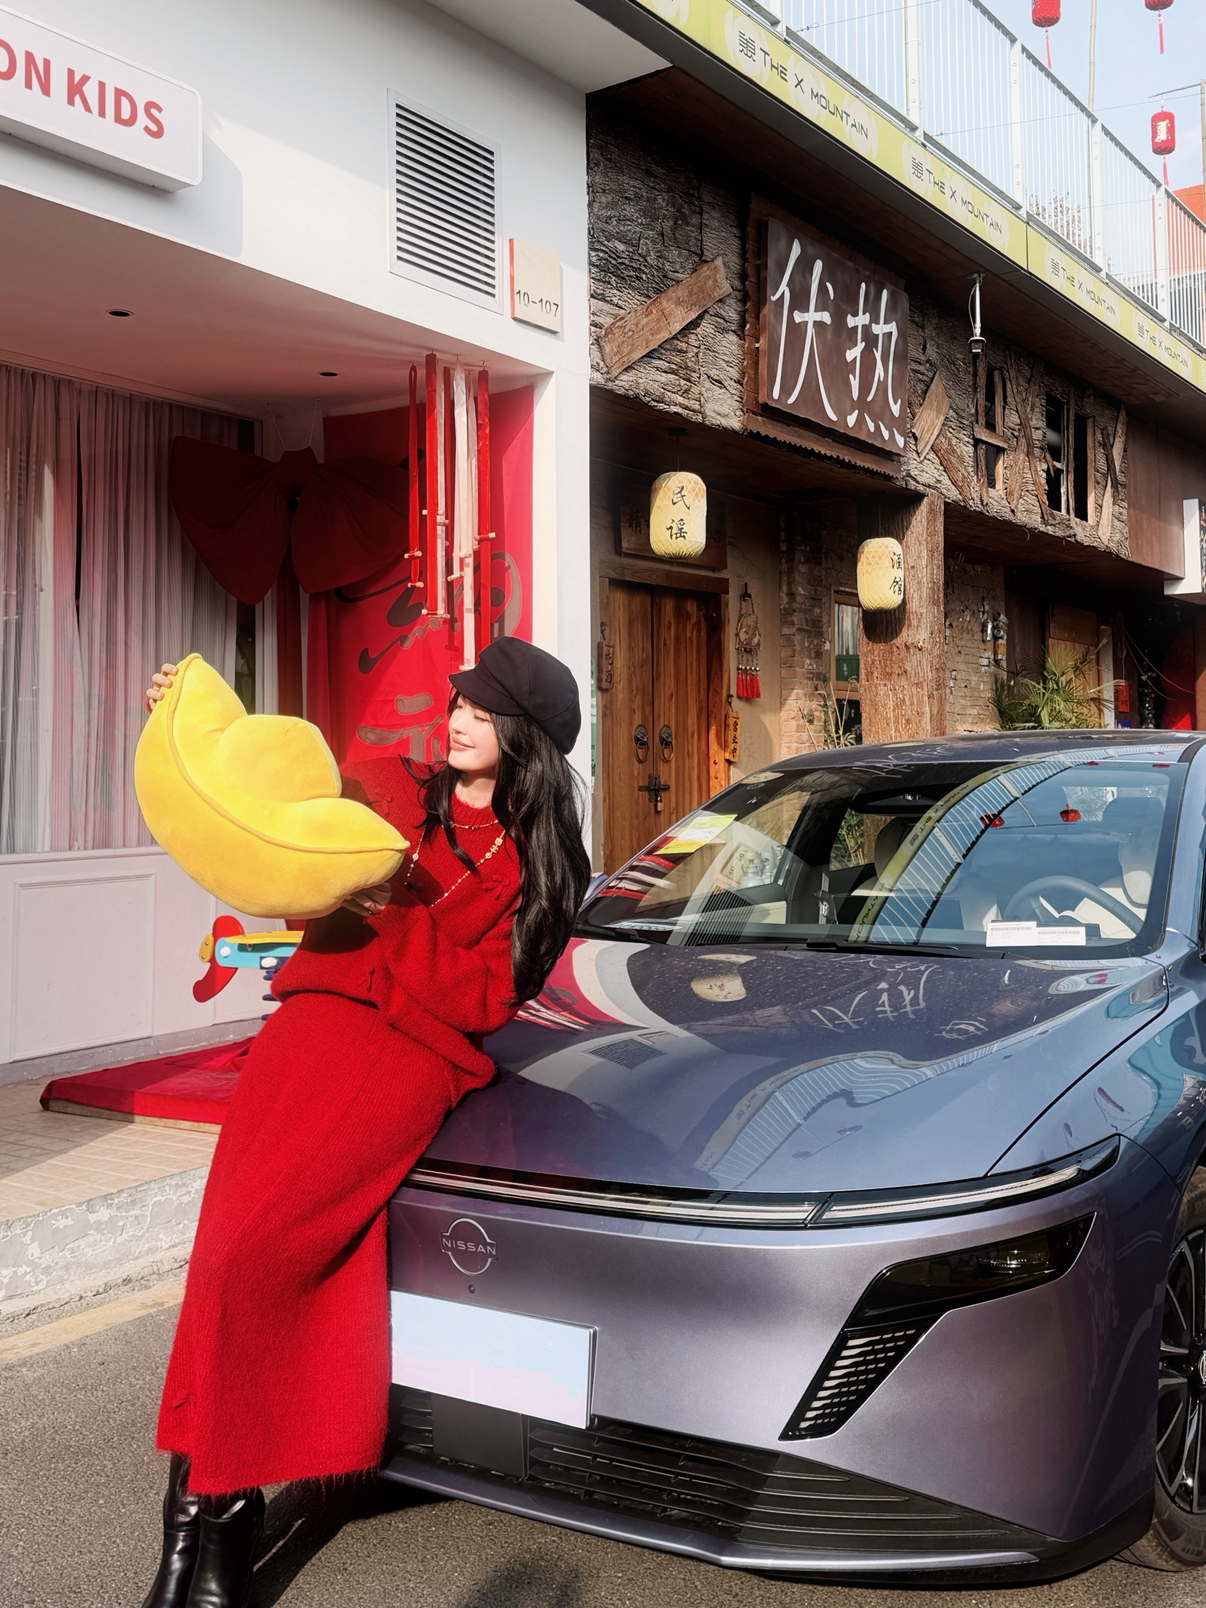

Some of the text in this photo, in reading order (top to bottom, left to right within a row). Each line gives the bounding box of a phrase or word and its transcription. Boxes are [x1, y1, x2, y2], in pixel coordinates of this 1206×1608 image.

[66, 67, 165, 140] KIDS
[759, 47, 869, 140] THE X MOUNTAIN
[925, 168, 946, 195] THE
[949, 185, 958, 203] X
[960, 196, 1003, 235] MOUNTAIN
[515, 289, 560, 318] 10-107
[1061, 266, 1076, 288] THE
[1077, 279, 1084, 293] X
[1085, 287, 1116, 316] MOUNTAIN
[666, 485, 691, 541] 民谣
[889, 551, 903, 596] 酒馆
[442, 1238, 496, 1255] NISSAN
